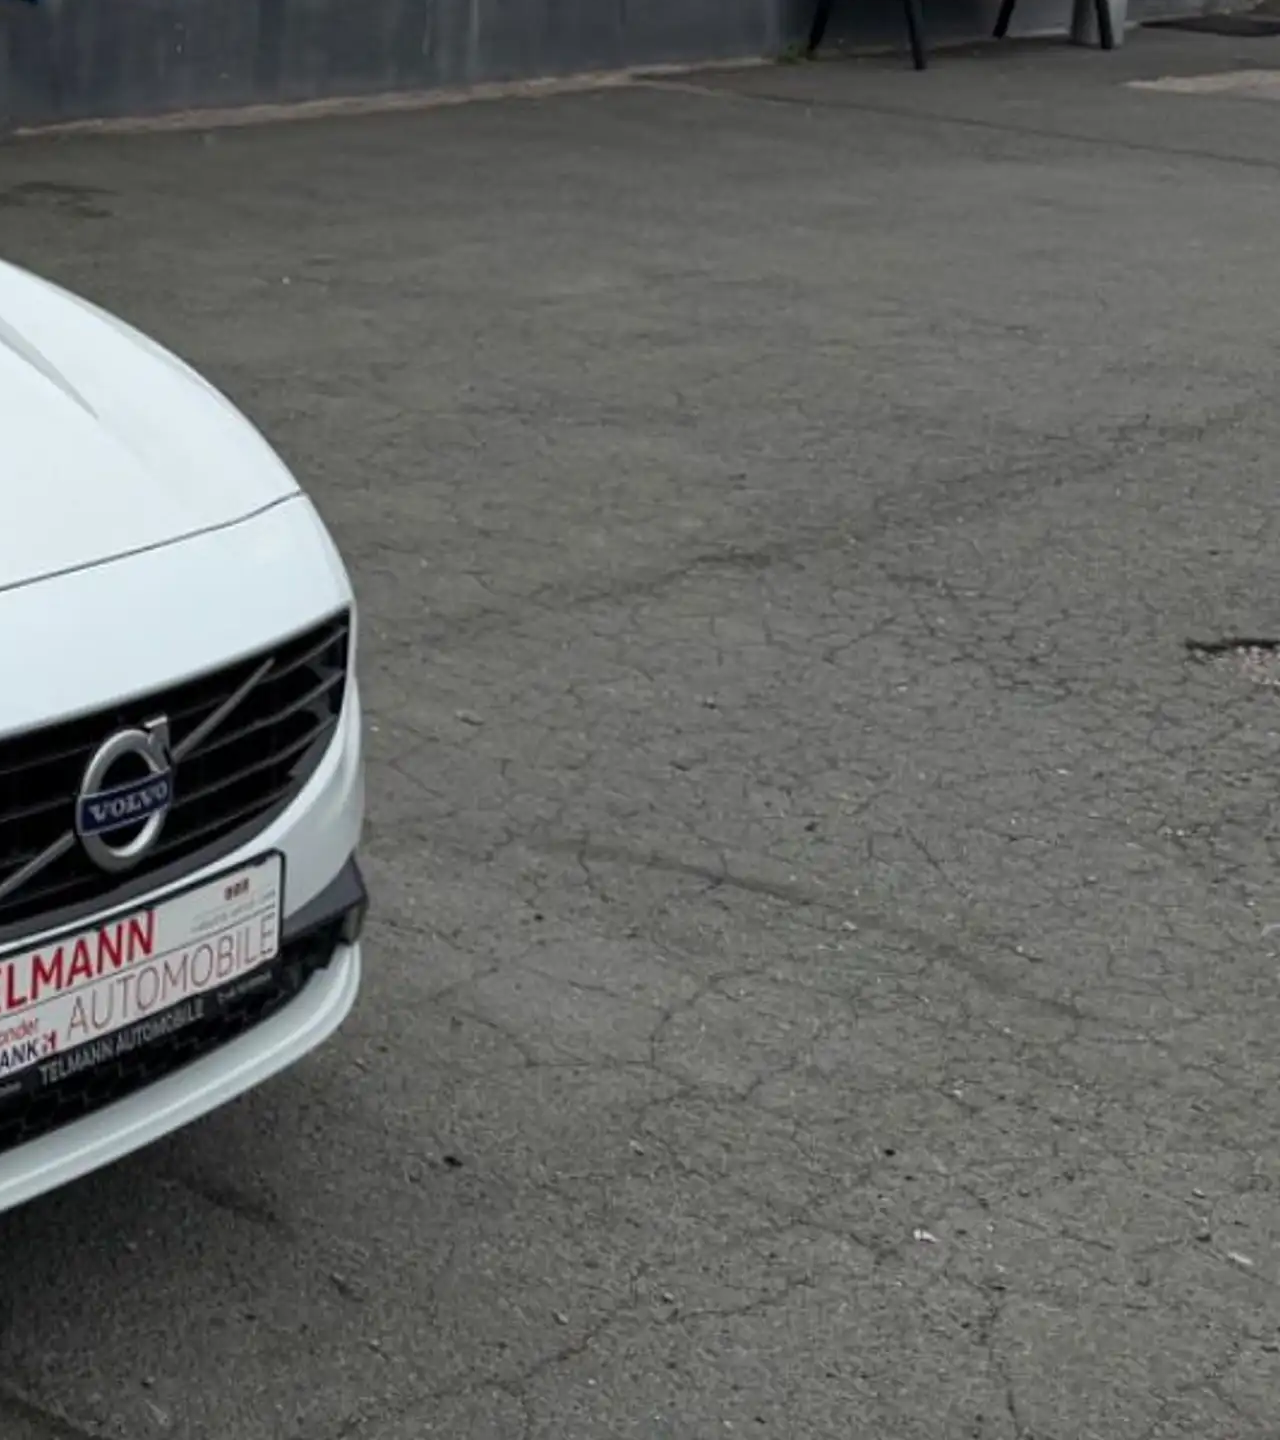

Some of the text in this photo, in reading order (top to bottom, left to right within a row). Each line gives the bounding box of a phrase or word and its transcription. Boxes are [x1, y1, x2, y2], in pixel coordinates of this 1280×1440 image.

[90, 781, 168, 822] VOLVO
[66, 911, 276, 1041] AUTOMOBILE
[39, 1036, 116, 1086] TELMANN
